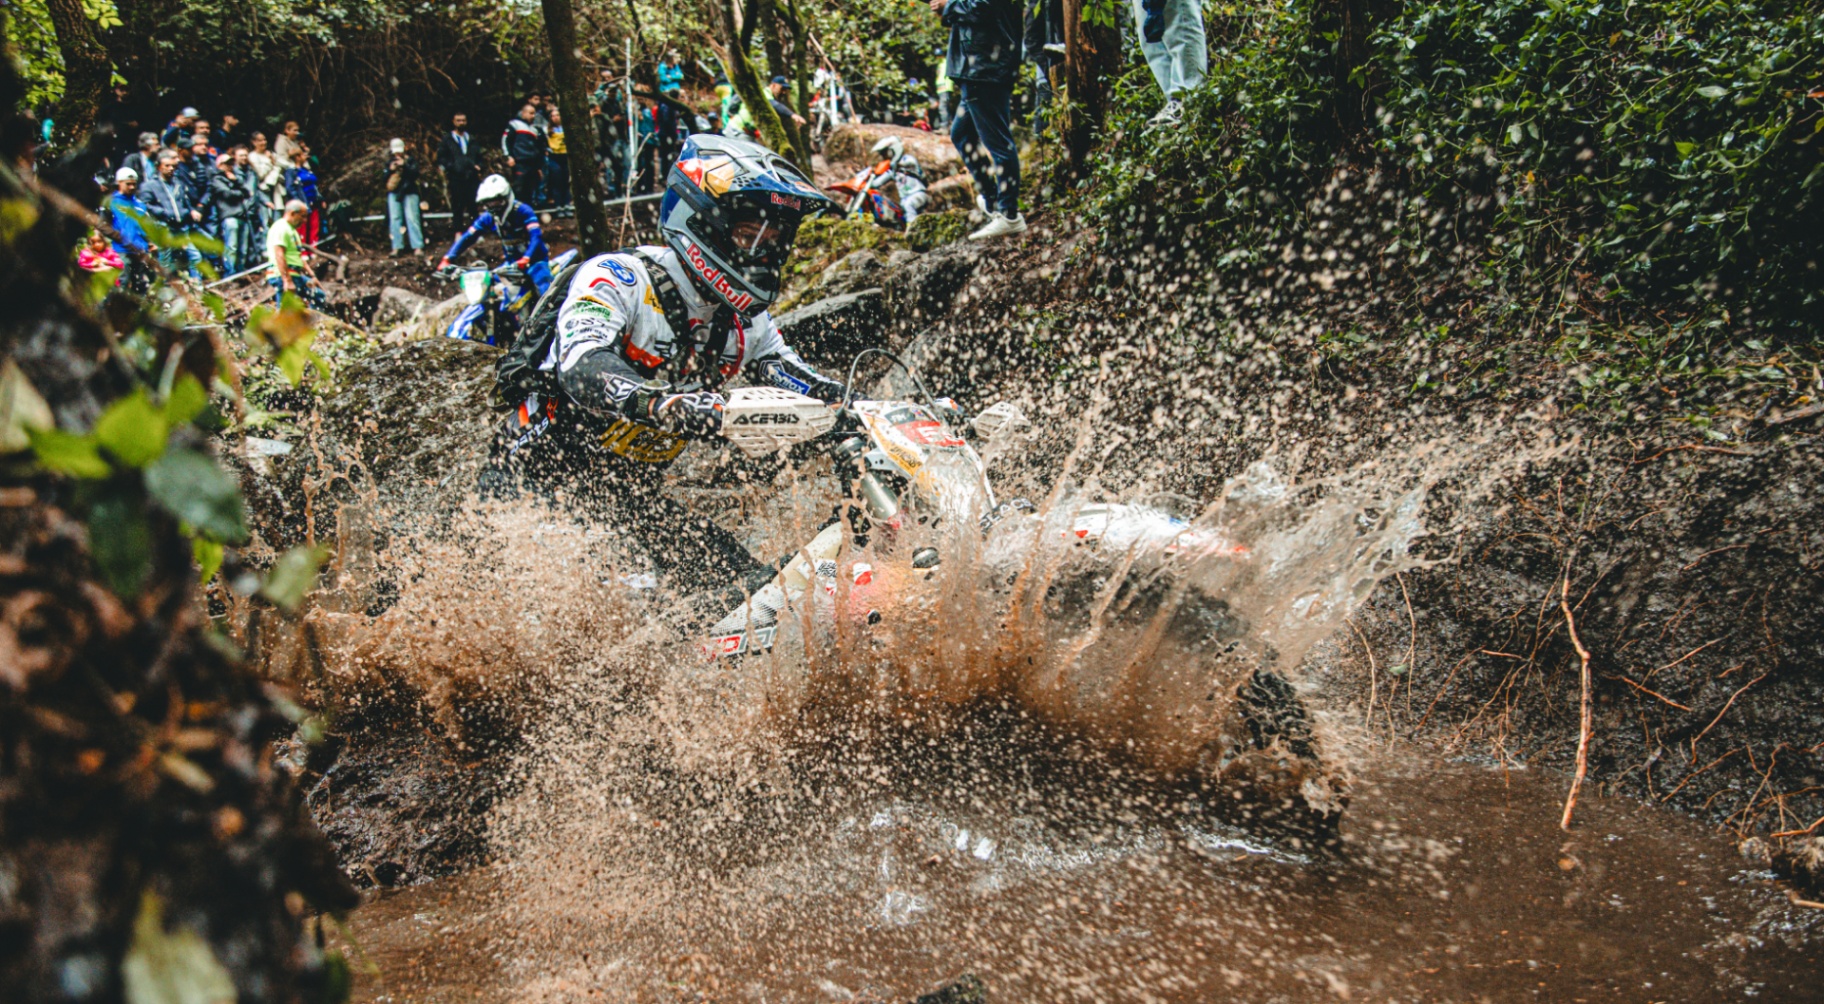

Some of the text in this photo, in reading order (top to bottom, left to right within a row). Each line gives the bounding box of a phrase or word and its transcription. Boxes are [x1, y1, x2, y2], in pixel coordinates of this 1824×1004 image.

[687, 243, 753, 312] Red Bull
[732, 413, 800, 425] ACERBIS
